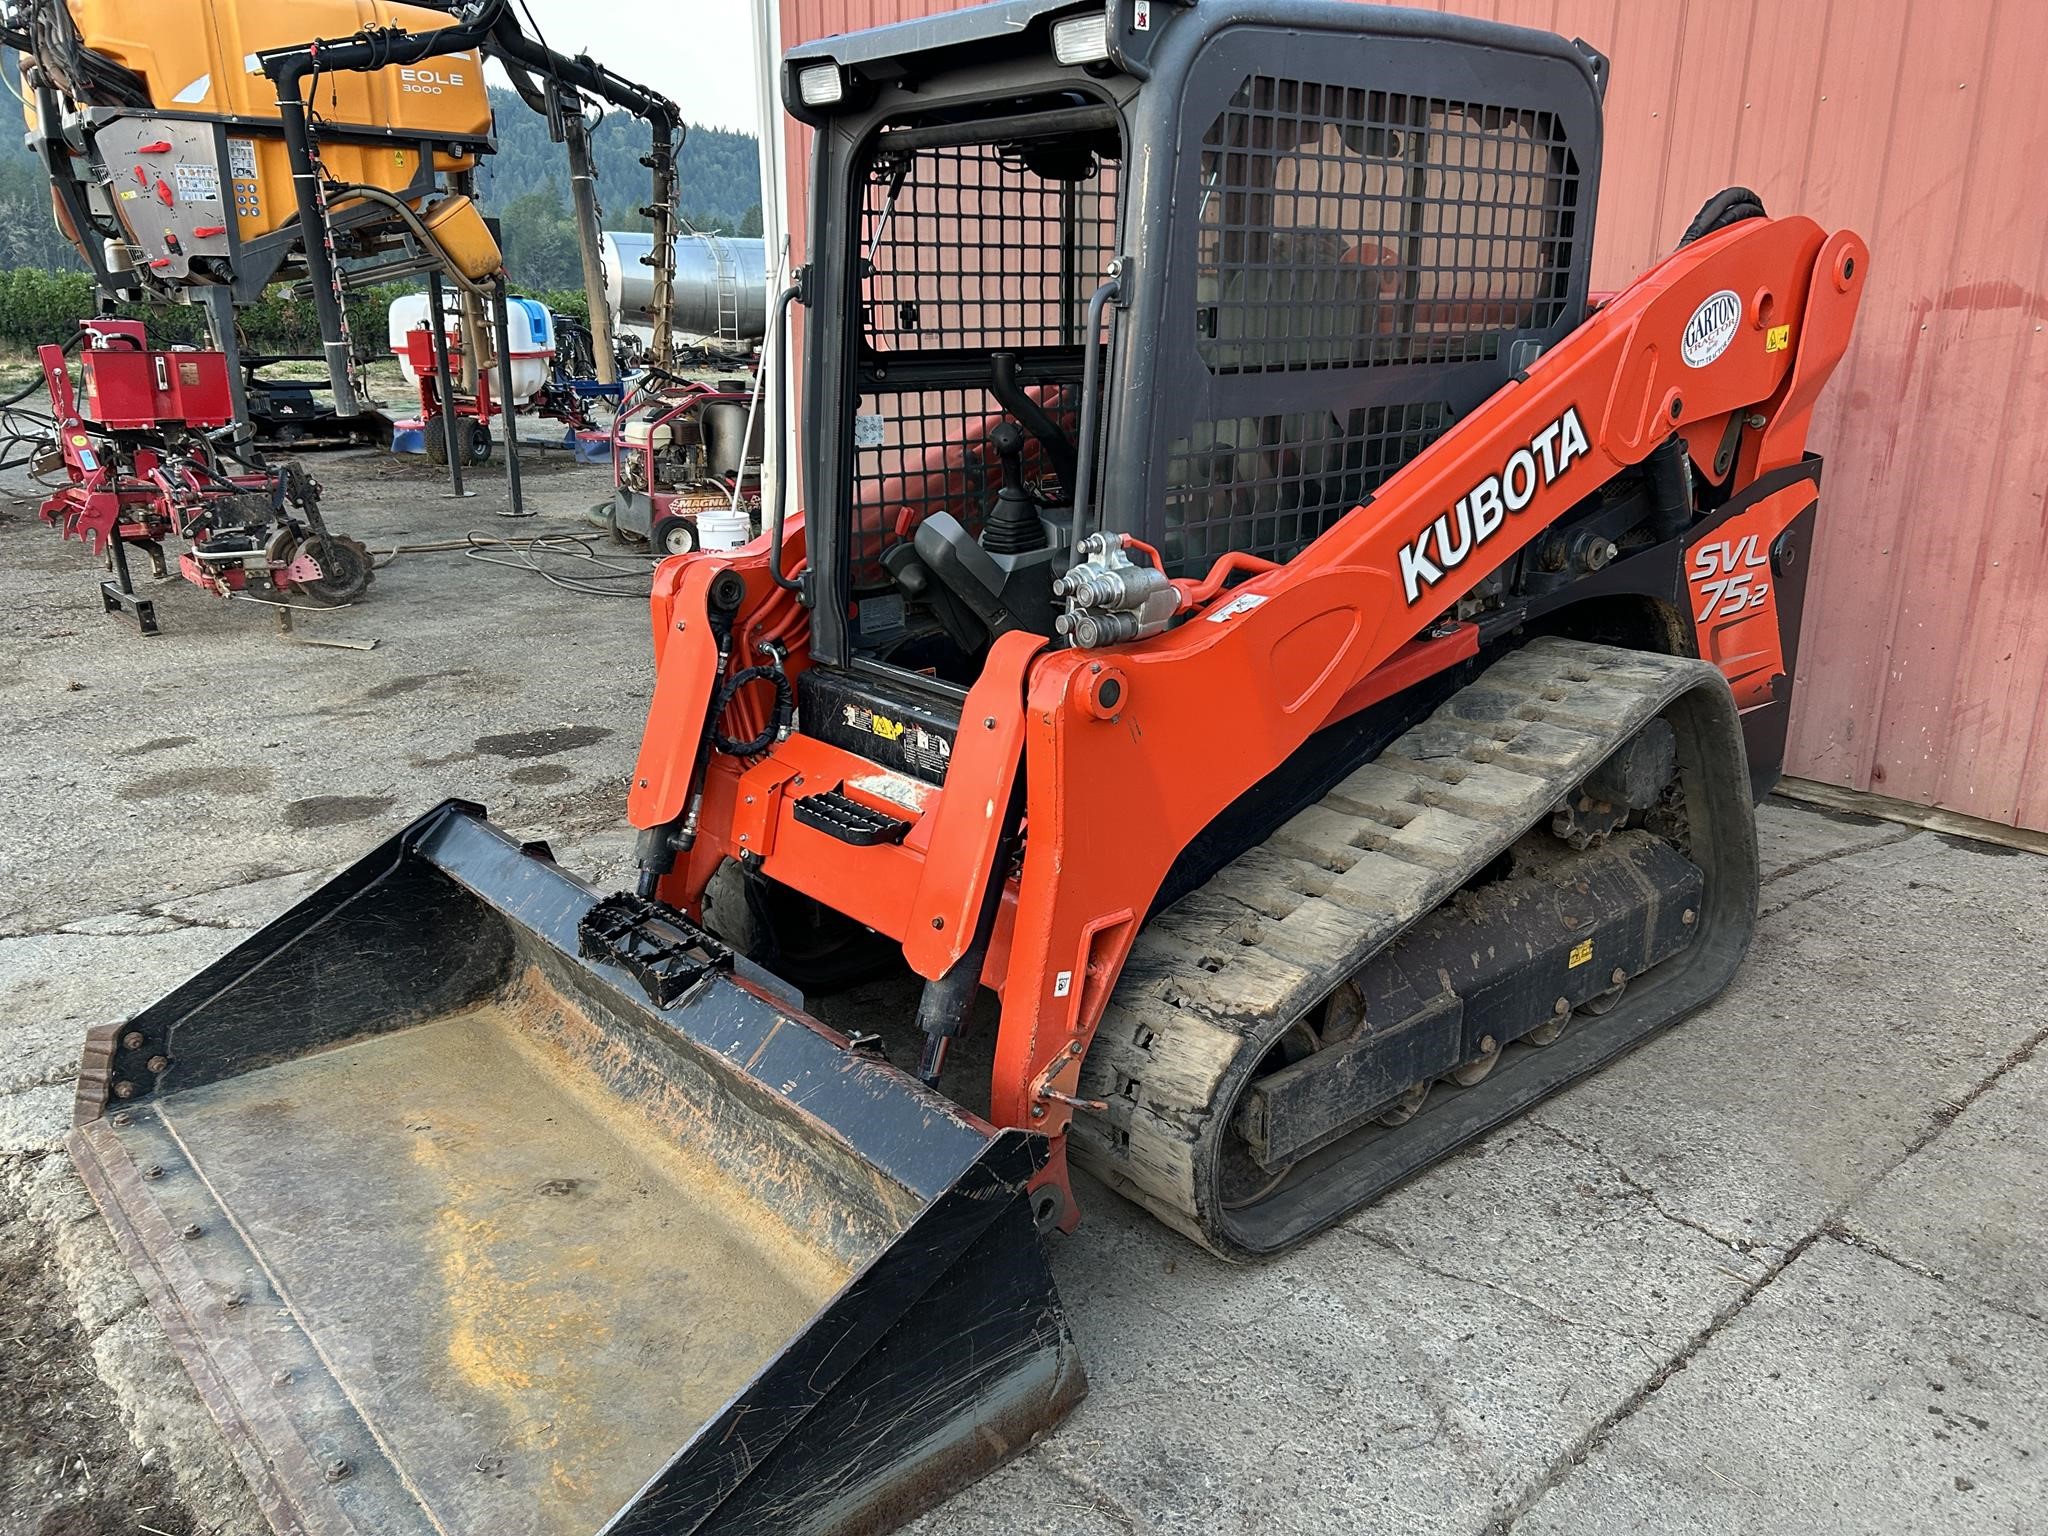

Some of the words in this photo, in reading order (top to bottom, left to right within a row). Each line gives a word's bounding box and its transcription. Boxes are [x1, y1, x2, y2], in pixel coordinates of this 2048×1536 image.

[401, 69, 464, 86] EOLE
[402, 84, 442, 94] 3000
[1686, 297, 1735, 347] GARTON
[1687, 318, 1735, 355] TRACTOR
[679, 498, 733, 508] MAGNU
[1398, 407, 1589, 604] KUBOTA
[1689, 534, 1767, 581] SVL
[1697, 573, 1769, 623] 75-2
